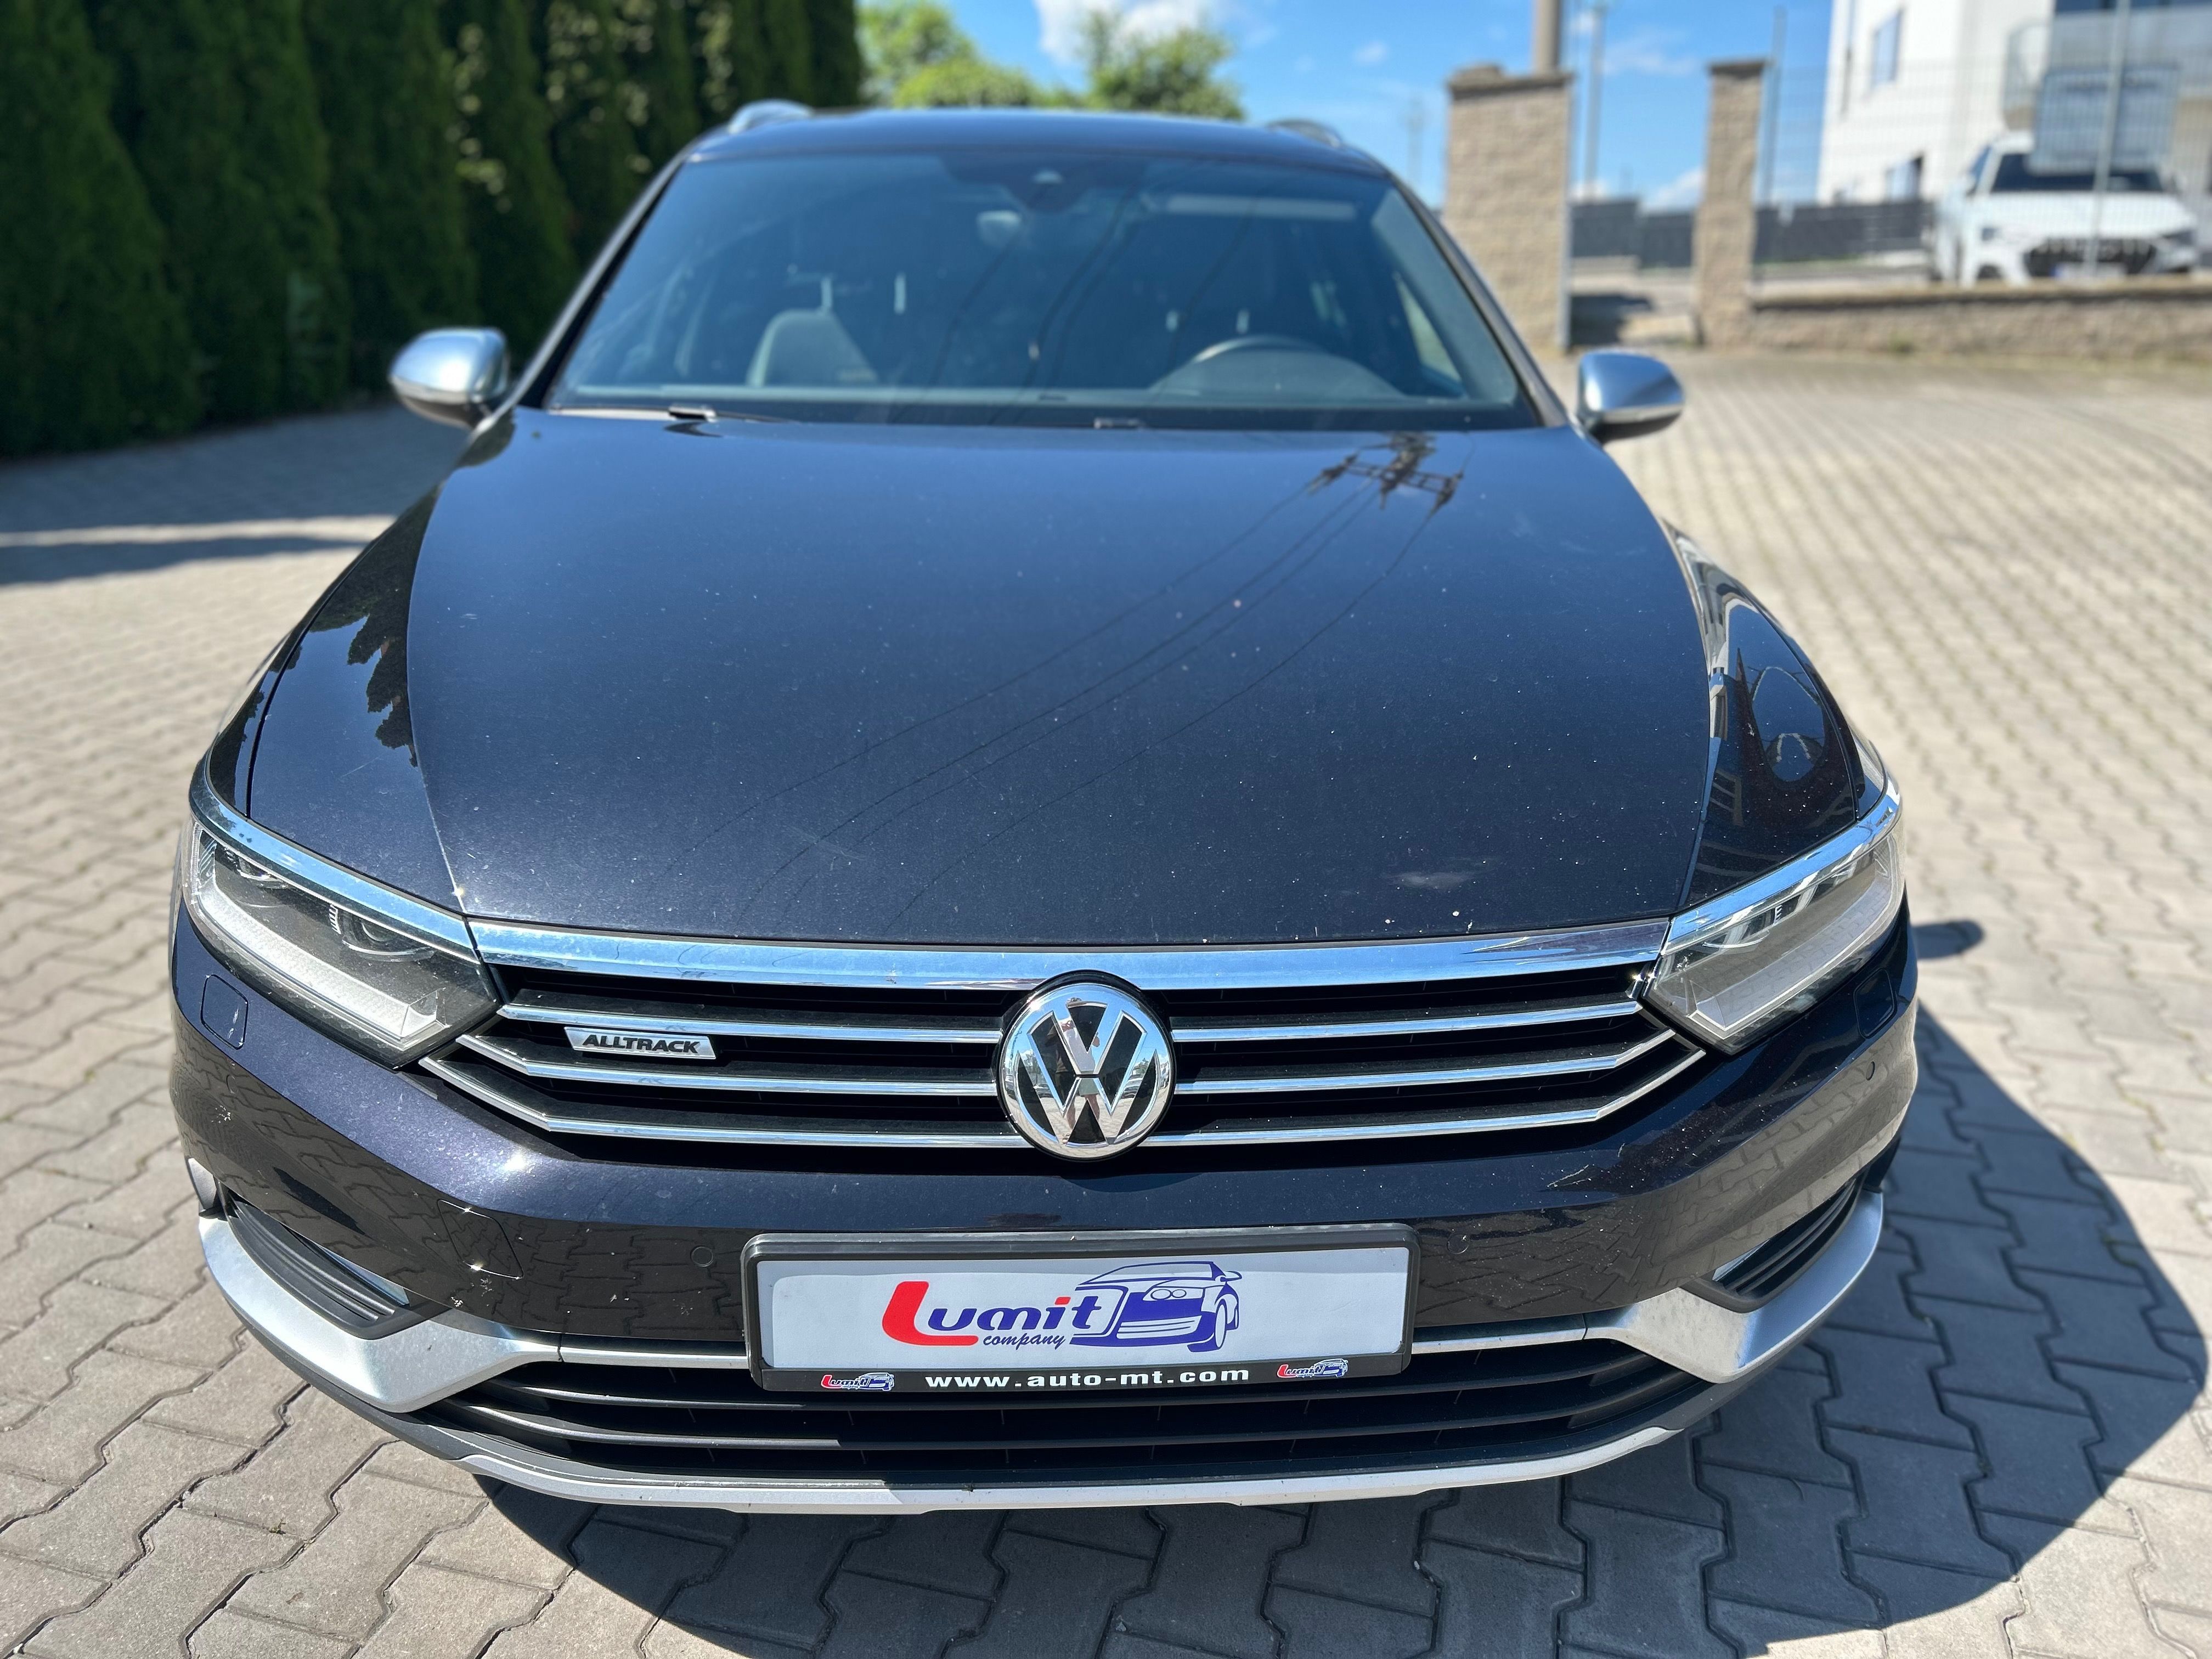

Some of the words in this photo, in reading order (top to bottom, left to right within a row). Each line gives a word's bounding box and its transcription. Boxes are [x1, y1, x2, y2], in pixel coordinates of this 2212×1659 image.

[582, 1034, 700, 1054] ALLTRACK
[881, 1280, 1102, 1346] Lumit
[983, 1333, 1066, 1350] company
[926, 1369, 1249, 1388] www.auto-mt.com
